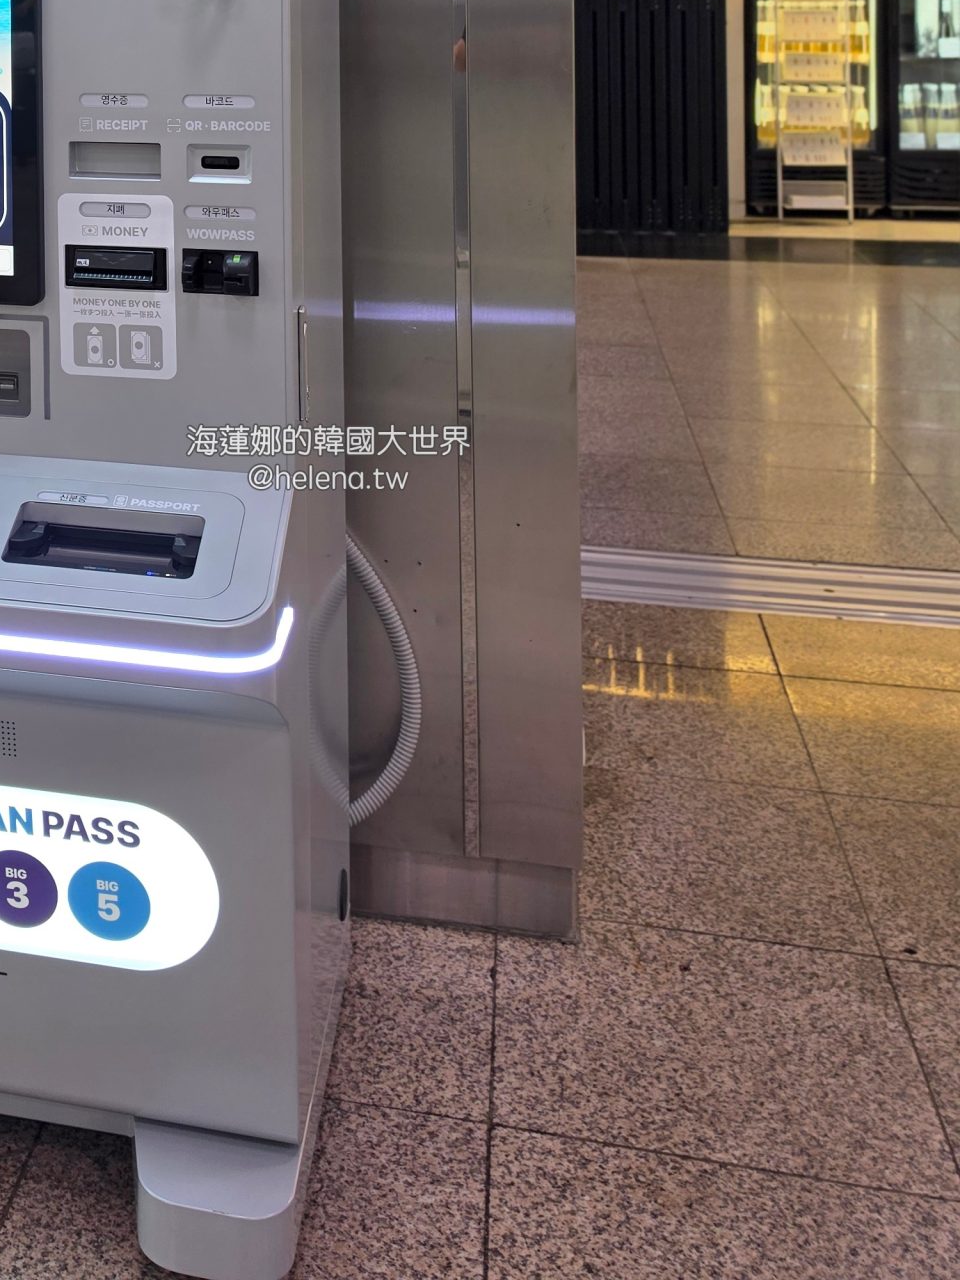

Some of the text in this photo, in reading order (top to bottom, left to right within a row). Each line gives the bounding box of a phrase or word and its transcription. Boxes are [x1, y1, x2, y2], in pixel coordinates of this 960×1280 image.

[101, 94, 129, 106] 영수증
[205, 96, 234, 107] 바코드
[96, 119, 148, 131] RECEIPT
[185, 120, 271, 132] QR BARCODE
[106, 204, 125, 215] 지폐
[202, 207, 241, 218] 와우패스
[101, 226, 148, 237] MONEY
[186, 228, 256, 241] WOWPASS
[73, 298, 161, 308] MONEY ONE BY ONE
[130, 498, 201, 512] PASSPORT
[42, 810, 141, 848] PASS
[5, 867, 28, 880] BIG
[95, 879, 119, 893] BIG
[6, 881, 30, 910] 3
[97, 894, 121, 923] 5
